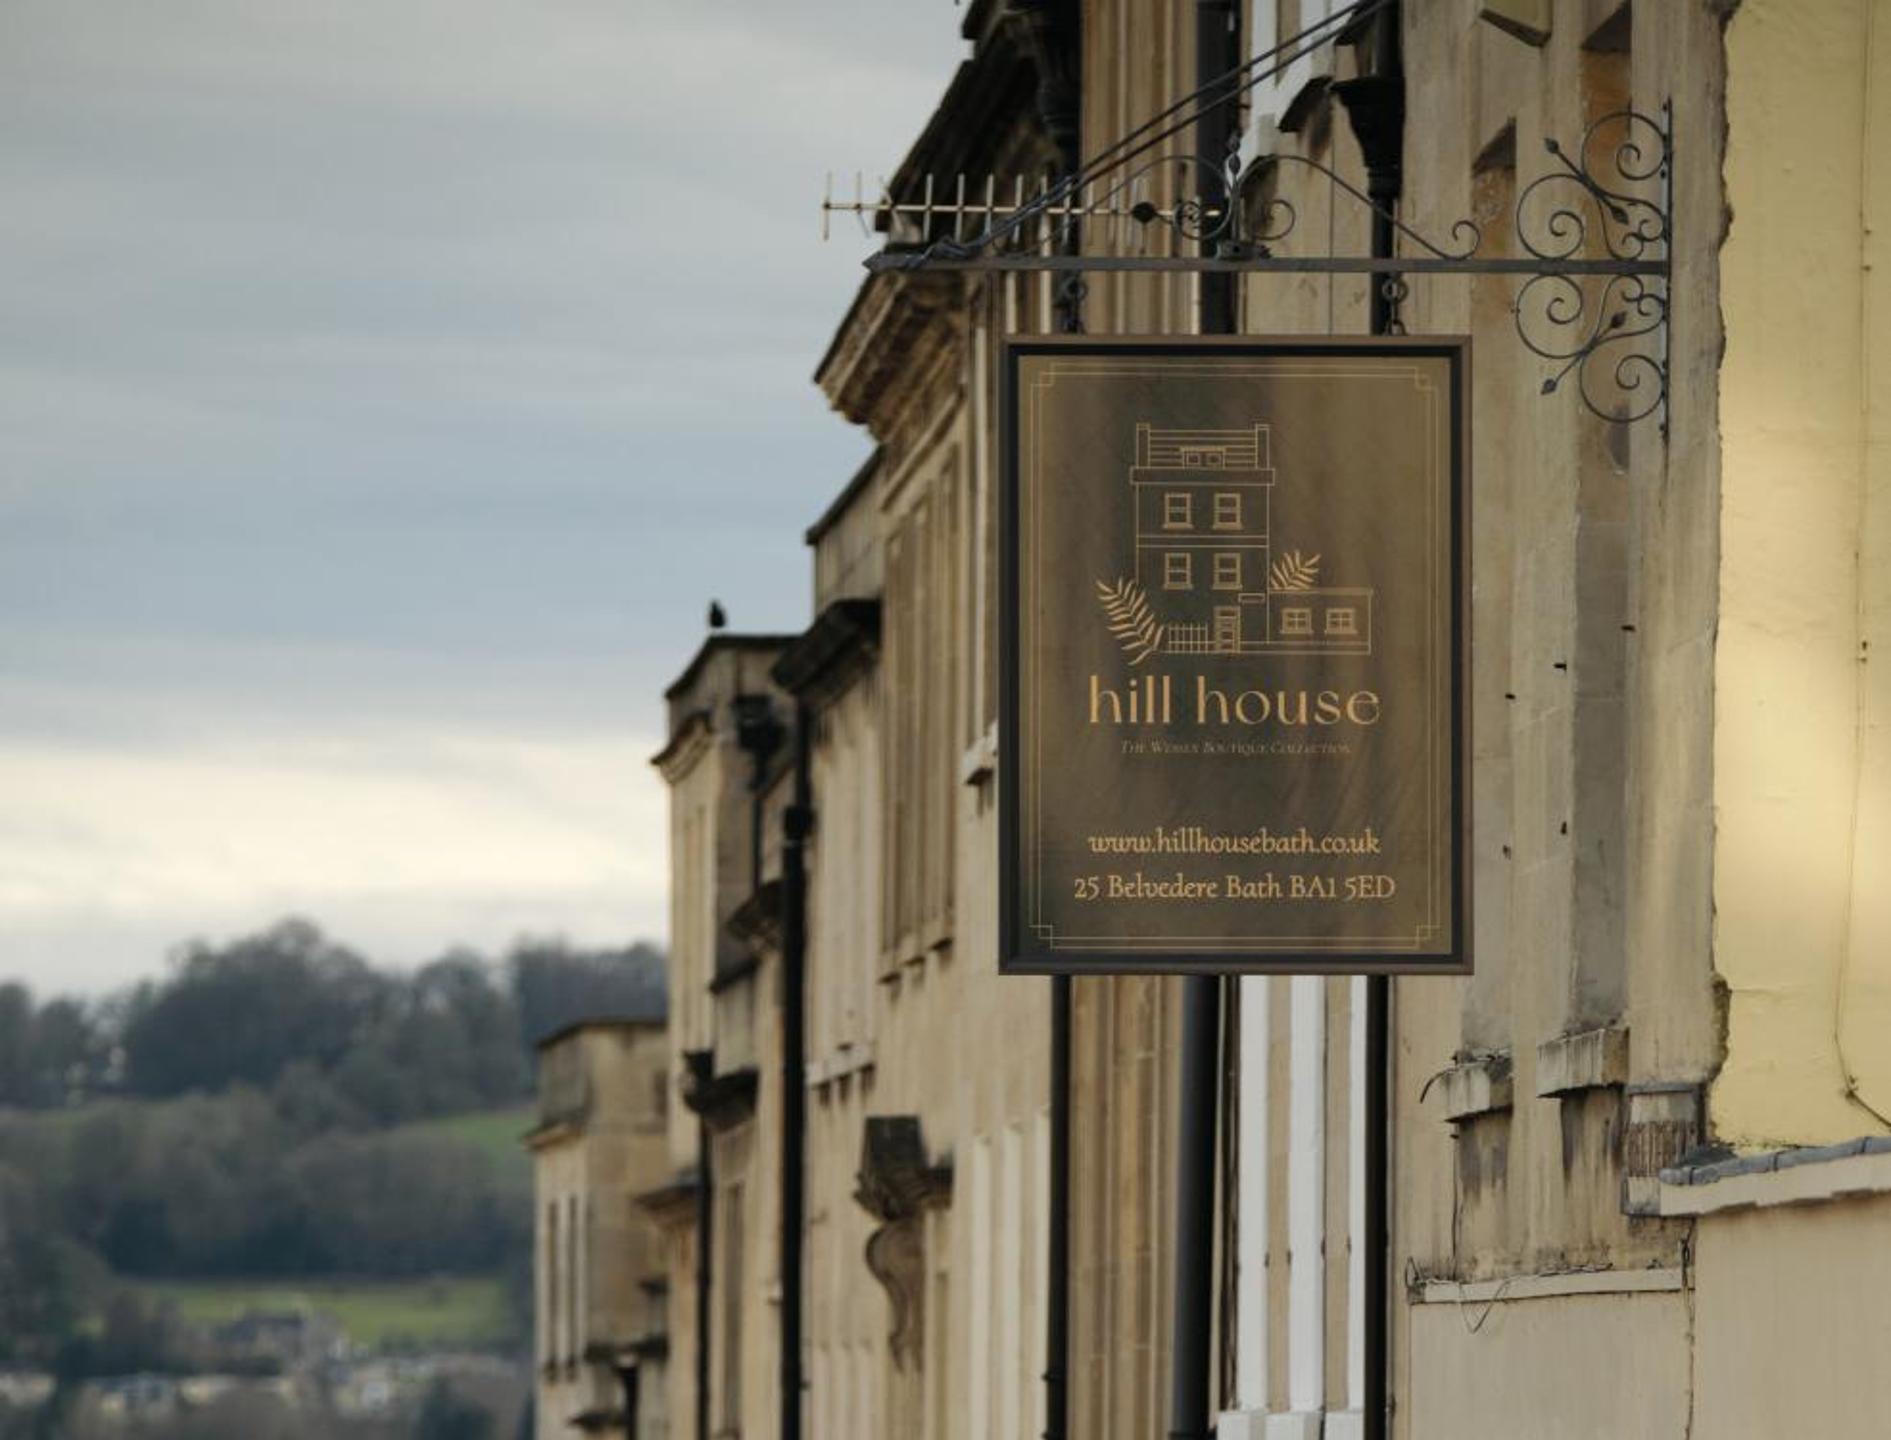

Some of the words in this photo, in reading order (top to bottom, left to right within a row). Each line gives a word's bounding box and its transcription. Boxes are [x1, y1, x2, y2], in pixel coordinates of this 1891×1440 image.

[1089, 674, 1170, 724] hill
[1197, 674, 1381, 726] house
[1087, 826, 1381, 854] www.hillhousebath.co.uk
[1073, 878, 1100, 900] 25
[1107, 871, 1218, 899] Belvedere
[1224, 873, 1284, 899] Bath
[1289, 874, 1338, 899] BA1
[1342, 874, 1397, 899] 5ED
